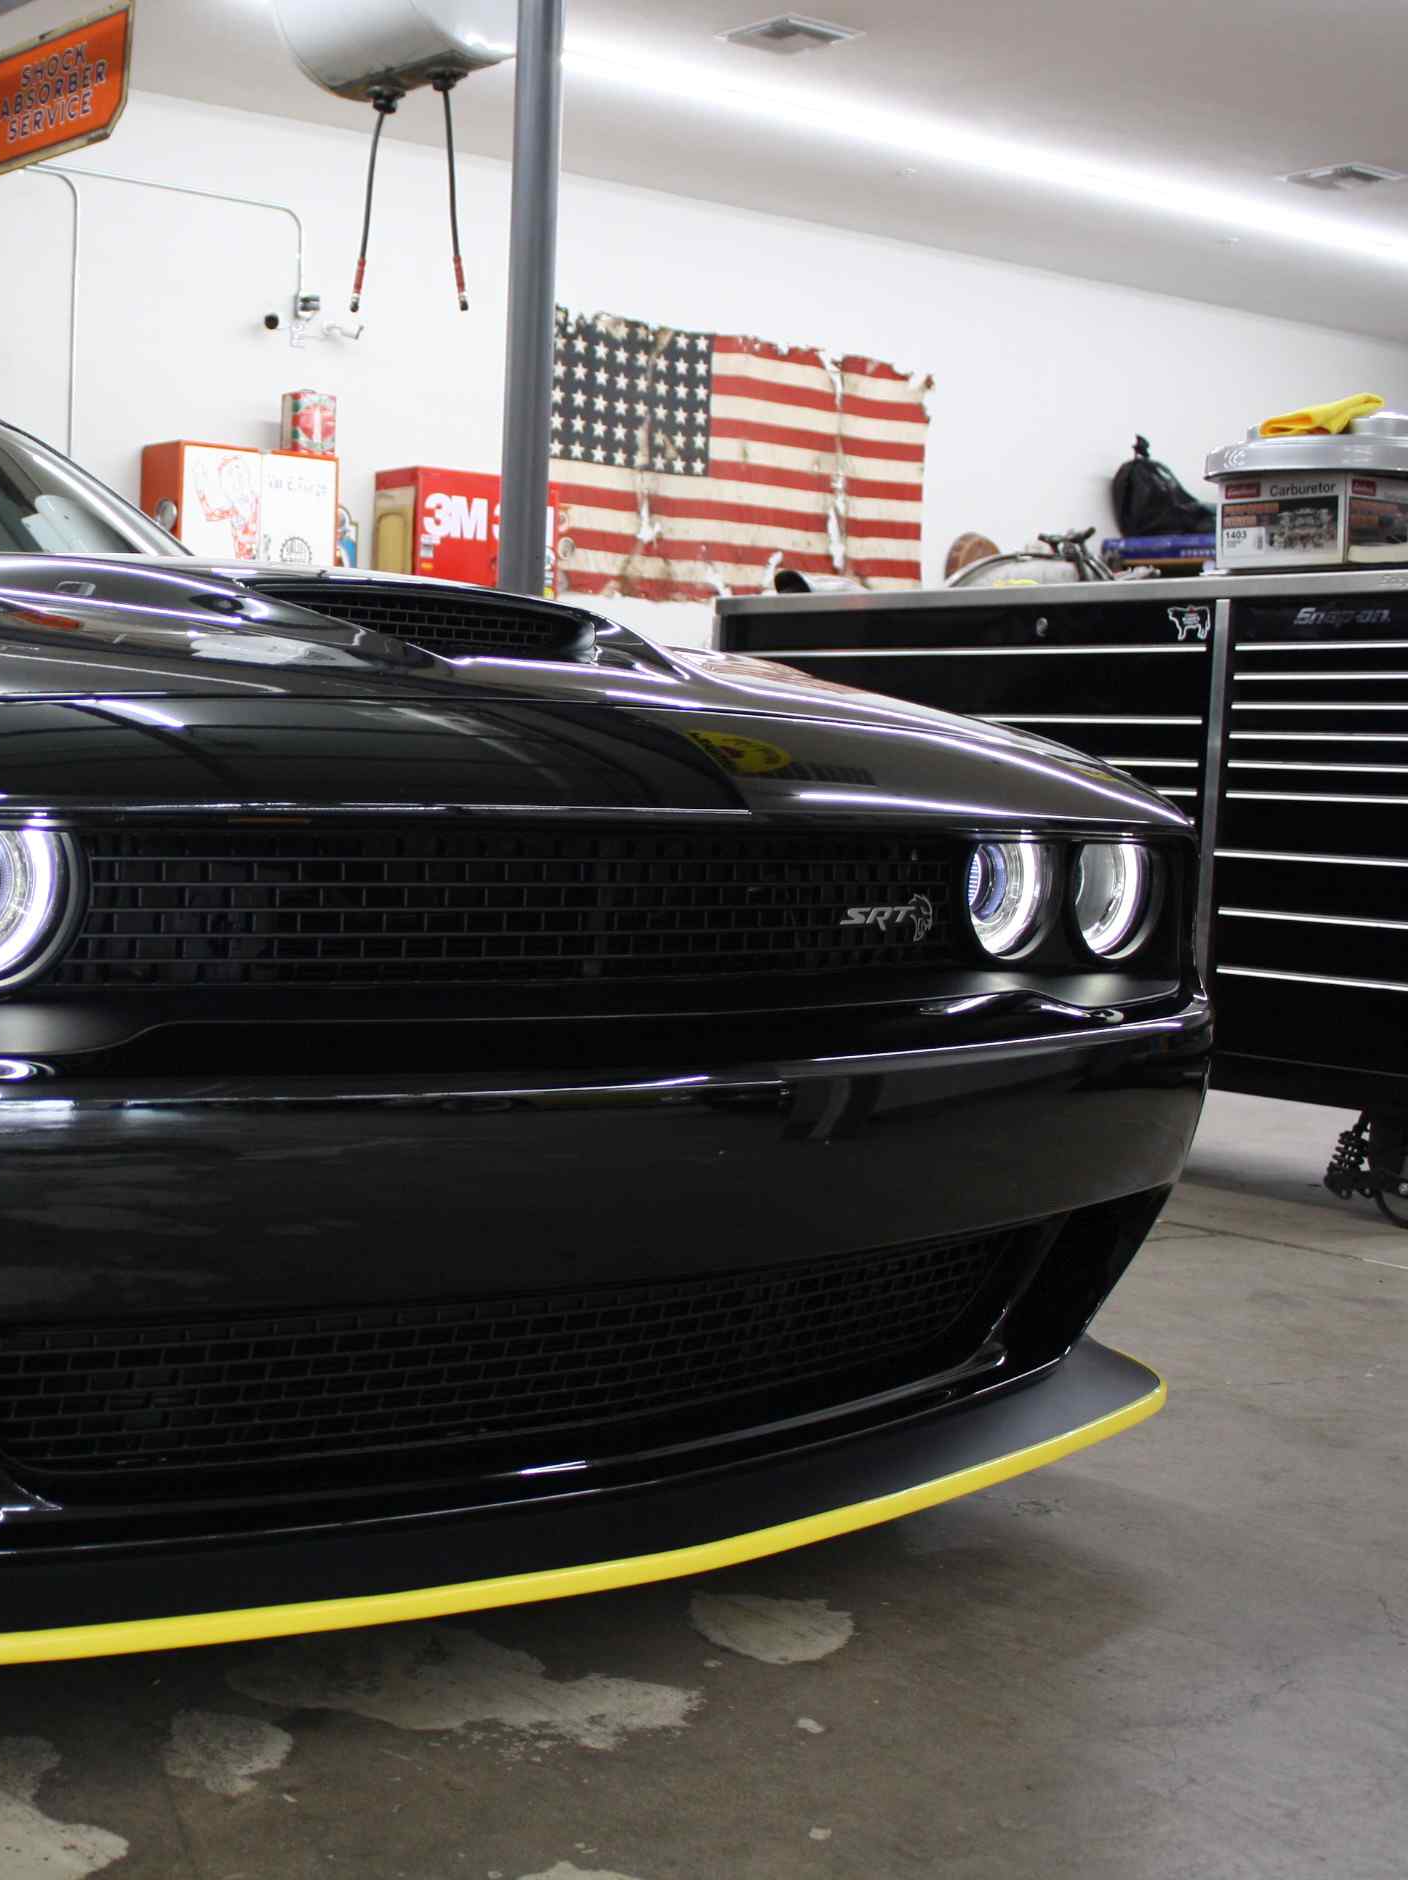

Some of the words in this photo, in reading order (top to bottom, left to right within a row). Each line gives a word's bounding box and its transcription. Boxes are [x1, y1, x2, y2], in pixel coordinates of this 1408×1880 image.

[21, 42, 88, 88] SHOCK
[0, 59, 107, 121] ABSORBER
[6, 89, 93, 144] SERVICE
[1269, 482, 1337, 497] Carburetor
[423, 492, 489, 542] 3M
[840, 906, 916, 931] SRT
